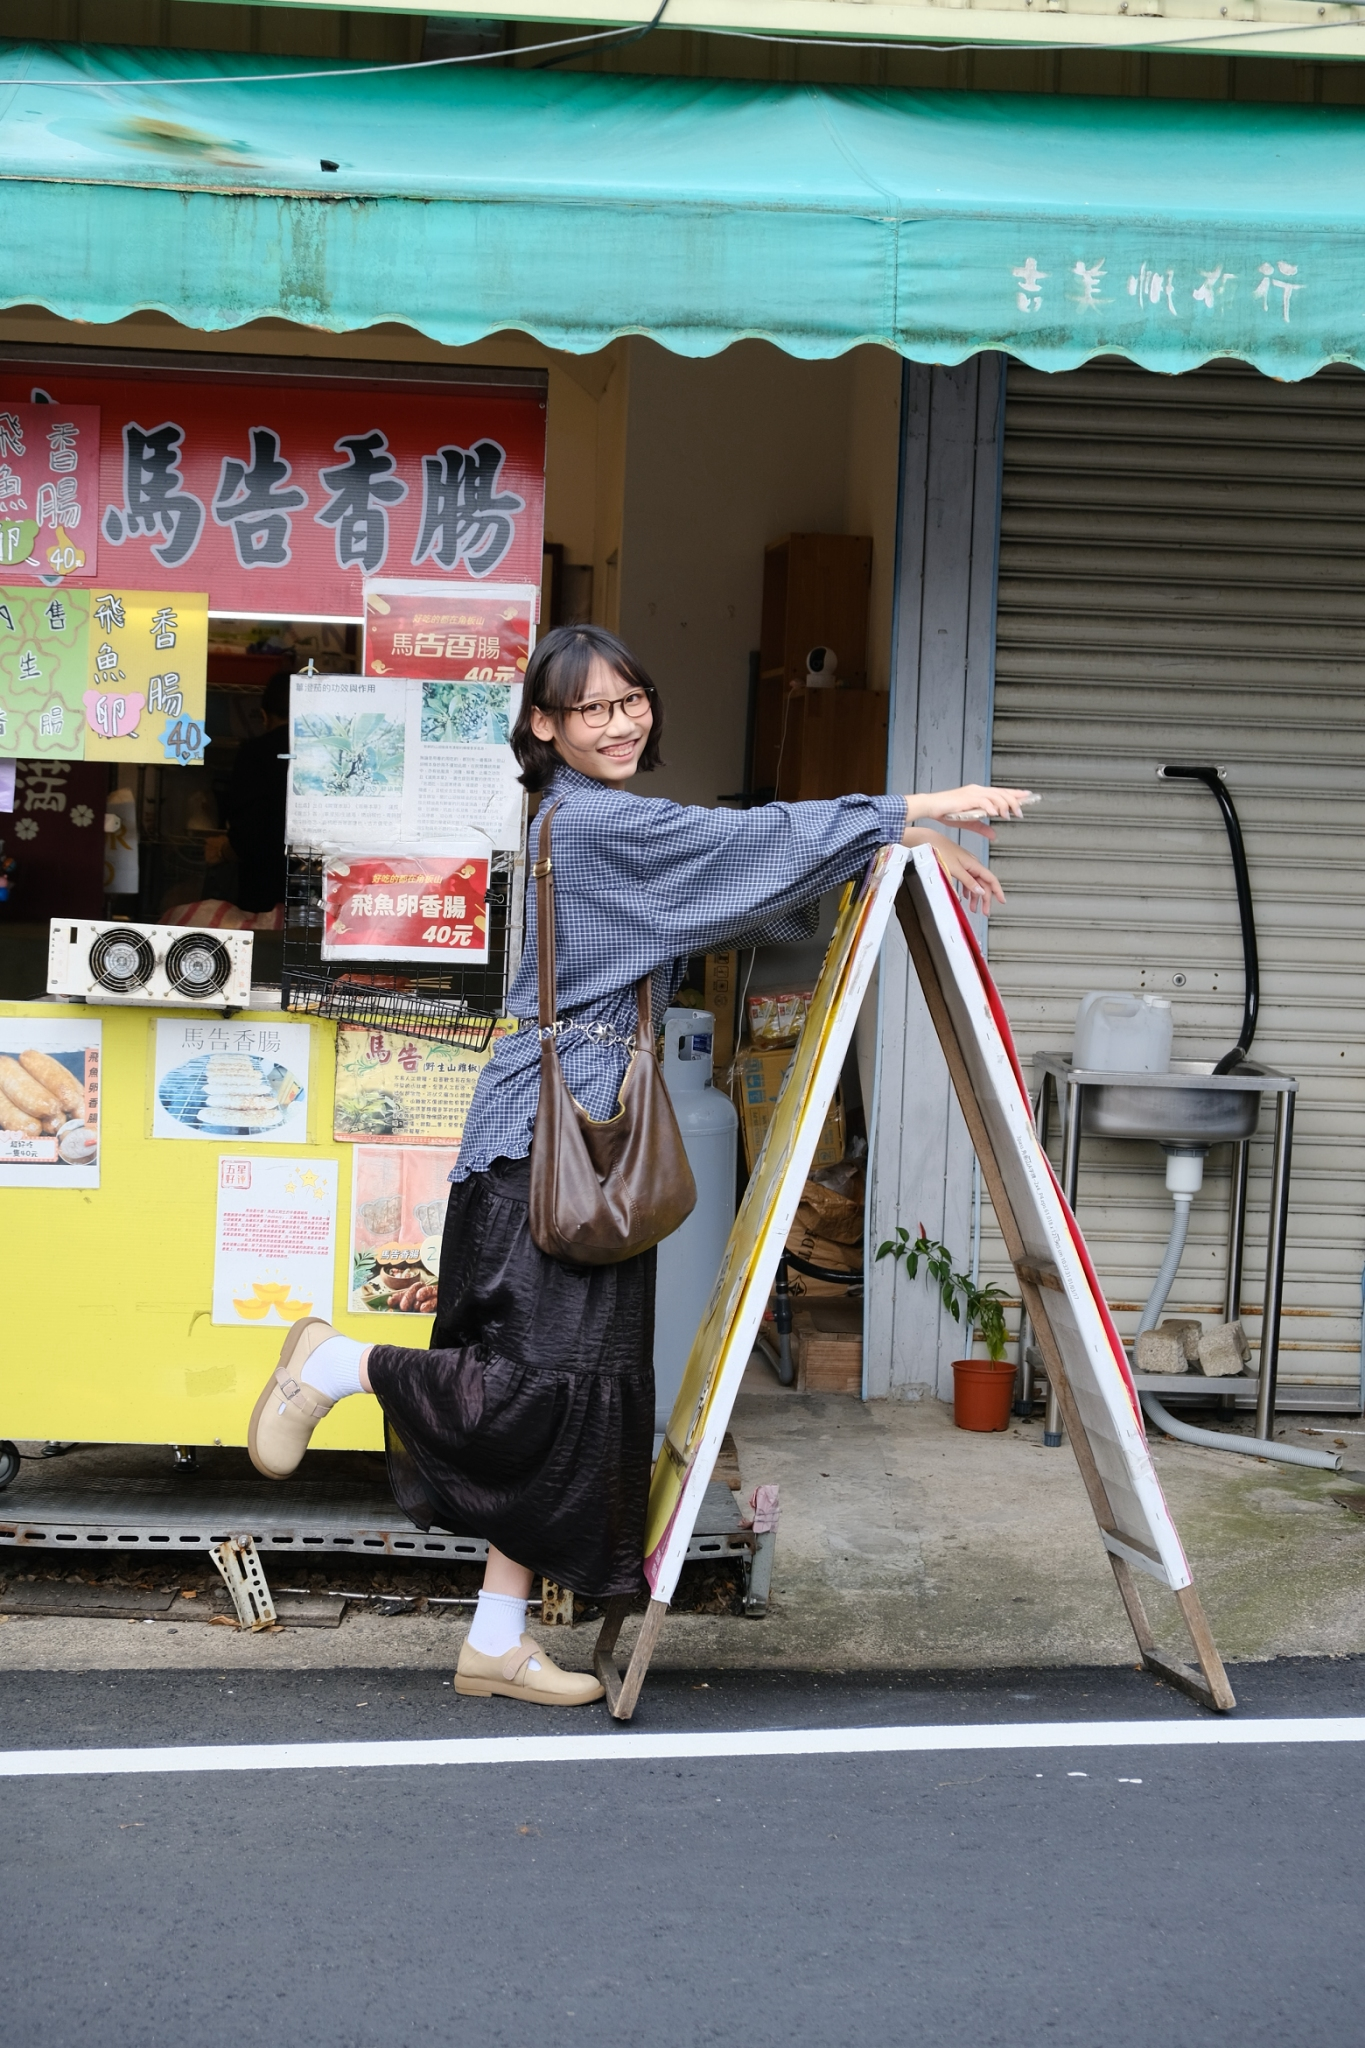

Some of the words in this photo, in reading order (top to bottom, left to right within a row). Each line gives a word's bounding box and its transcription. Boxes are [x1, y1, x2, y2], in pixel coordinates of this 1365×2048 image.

[37, 423, 81, 528] 香腸
[101, 420, 526, 577] 馬告香腸
[148, 607, 184, 717] 香腸
[391, 633, 501, 660] 馬告香腸
[18, 650, 42, 681] 生
[94, 594, 126, 737] 飛魚卵
[371, 873, 443, 885] 好吃的都在角板山
[350, 893, 467, 919] 飛魚卵香腸
[422, 924, 474, 947] 40元
[181, 1027, 282, 1054] 馬告香腸
[365, 1034, 423, 1073] 馬告
[87, 1051, 99, 1125] 飛魚卵香腸
[380, 1249, 421, 1260] 馬告香腸
